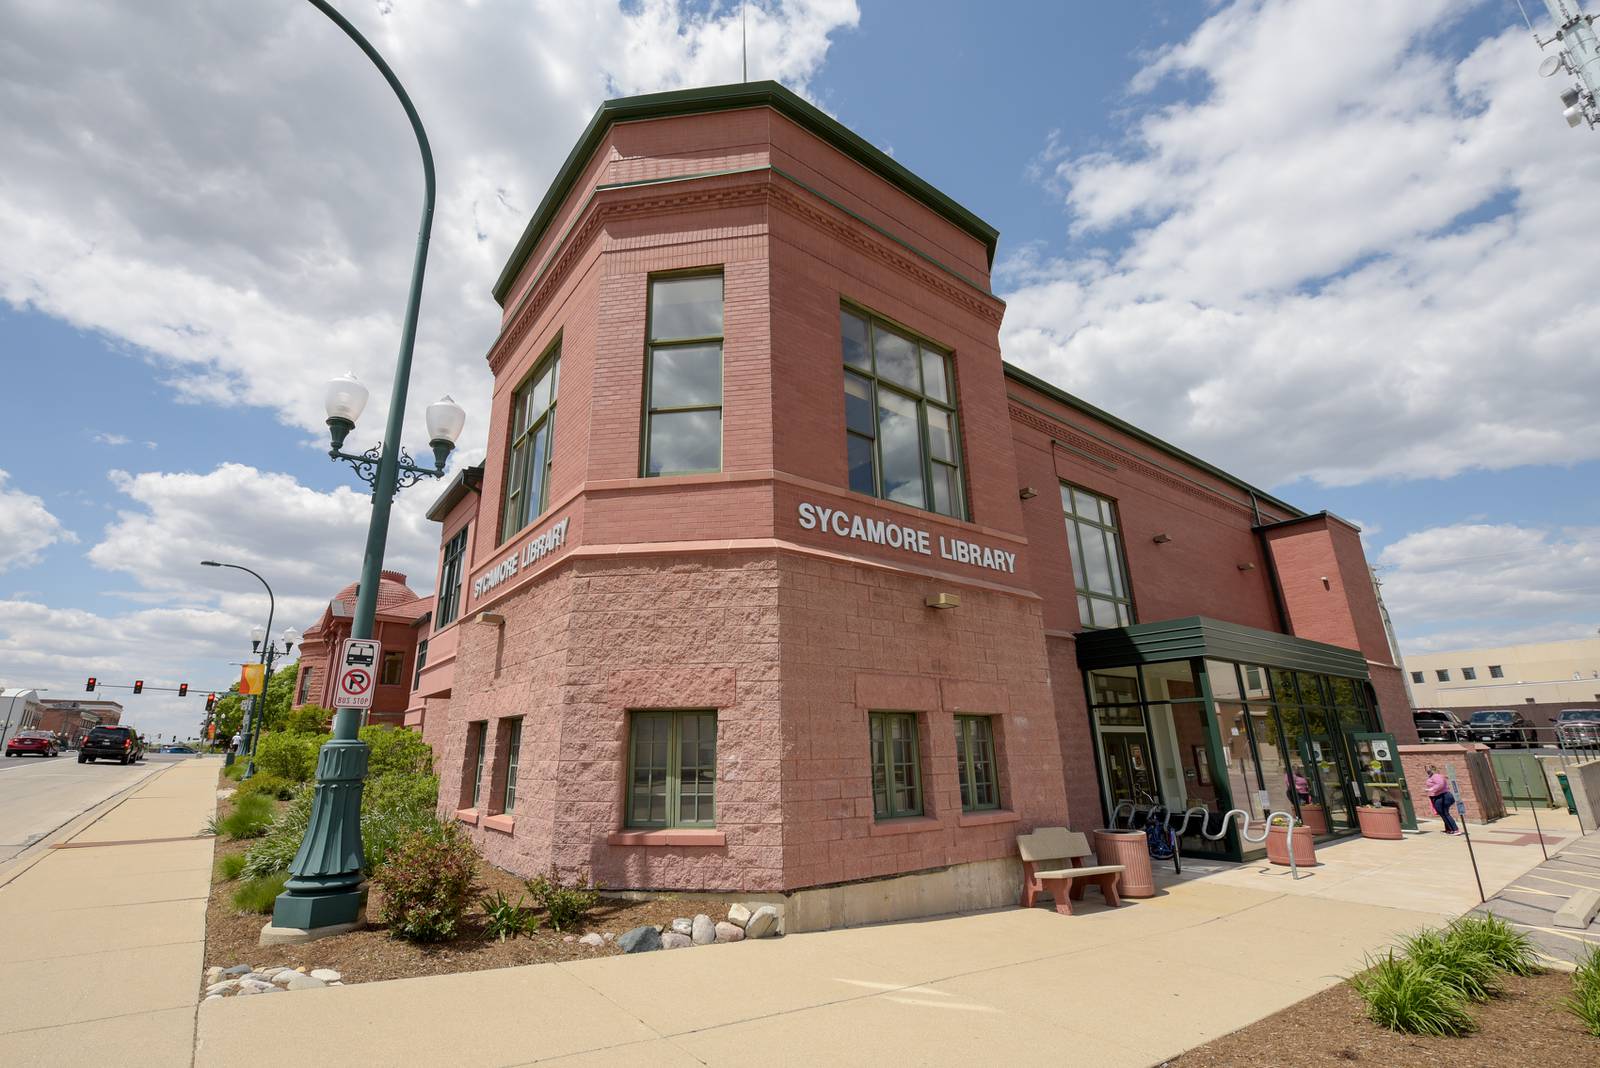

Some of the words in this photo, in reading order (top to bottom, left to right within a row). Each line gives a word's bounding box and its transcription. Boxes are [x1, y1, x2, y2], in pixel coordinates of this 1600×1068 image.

[474, 551, 519, 600] SYCAMORE
[521, 516, 570, 568] LIBRARY
[798, 502, 932, 556] SYCAMORE
[939, 536, 1016, 574] LIBRARY
[337, 696, 350, 704] BUS
[352, 697, 369, 705] STOP
